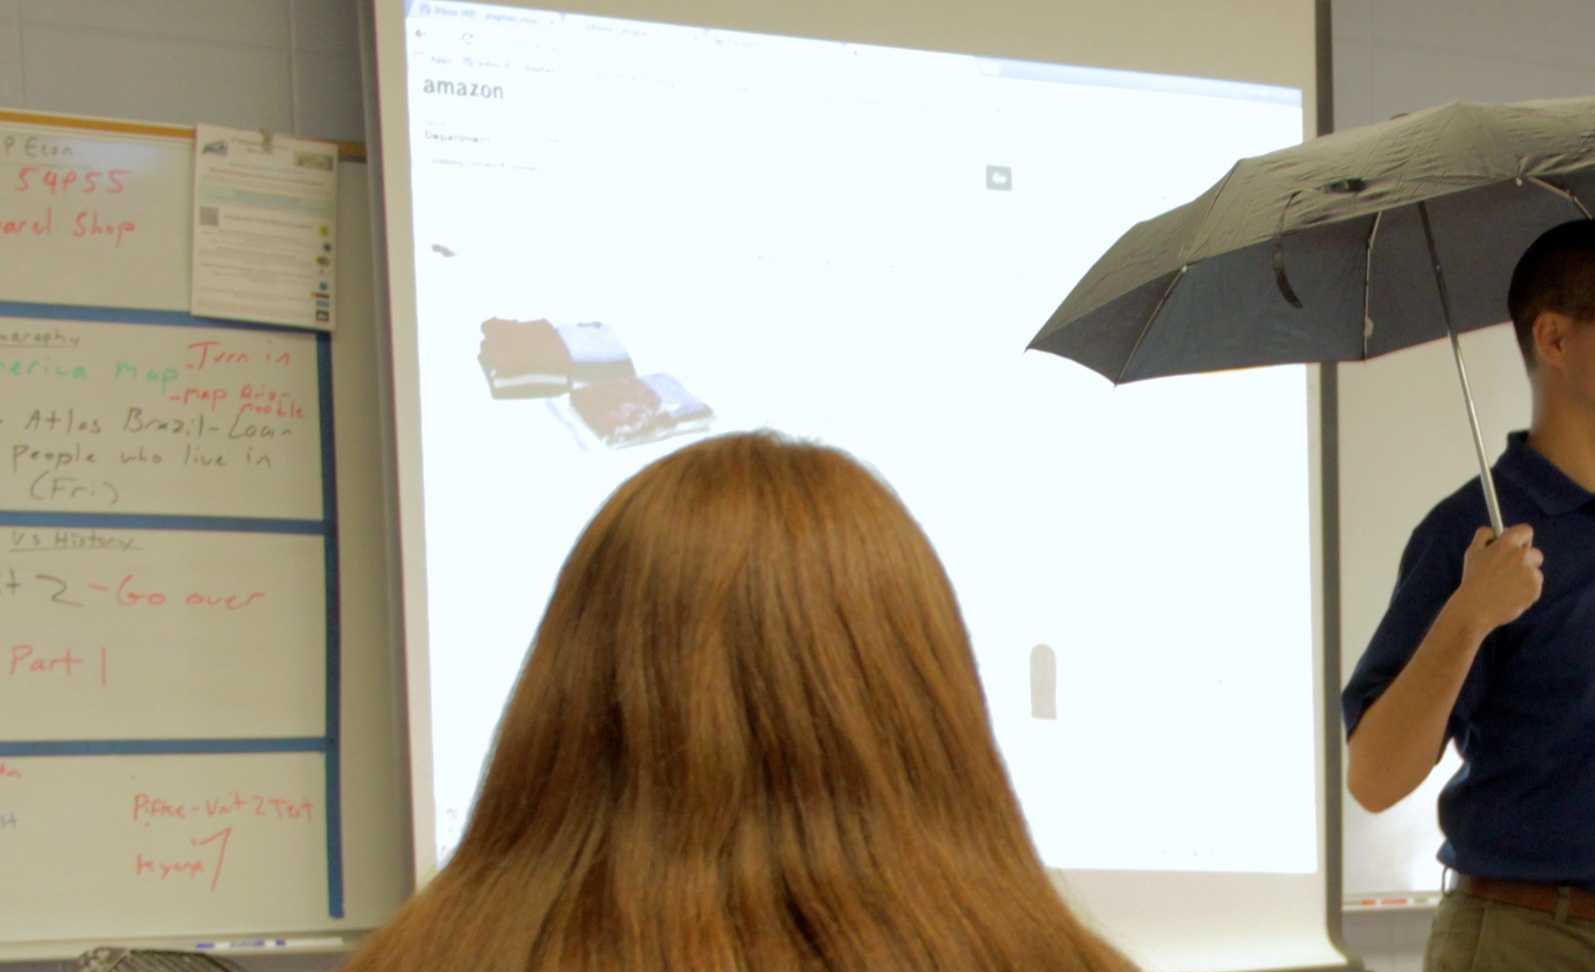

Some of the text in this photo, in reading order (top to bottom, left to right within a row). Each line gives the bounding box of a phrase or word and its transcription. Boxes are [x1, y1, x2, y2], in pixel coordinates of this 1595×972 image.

[422, 77, 505, 100] amazon
[71, 213, 137, 248] Shop
[0, 358, 89, 380] erica
[24, 407, 102, 435] Atlas
[120, 442, 164, 465] who
[184, 444, 229, 468] live
[245, 444, 273, 469] in
[55, 528, 135, 552] History
[34, 572, 85, 608] 2
[184, 591, 266, 610] over
[9, 643, 84, 676] Part
